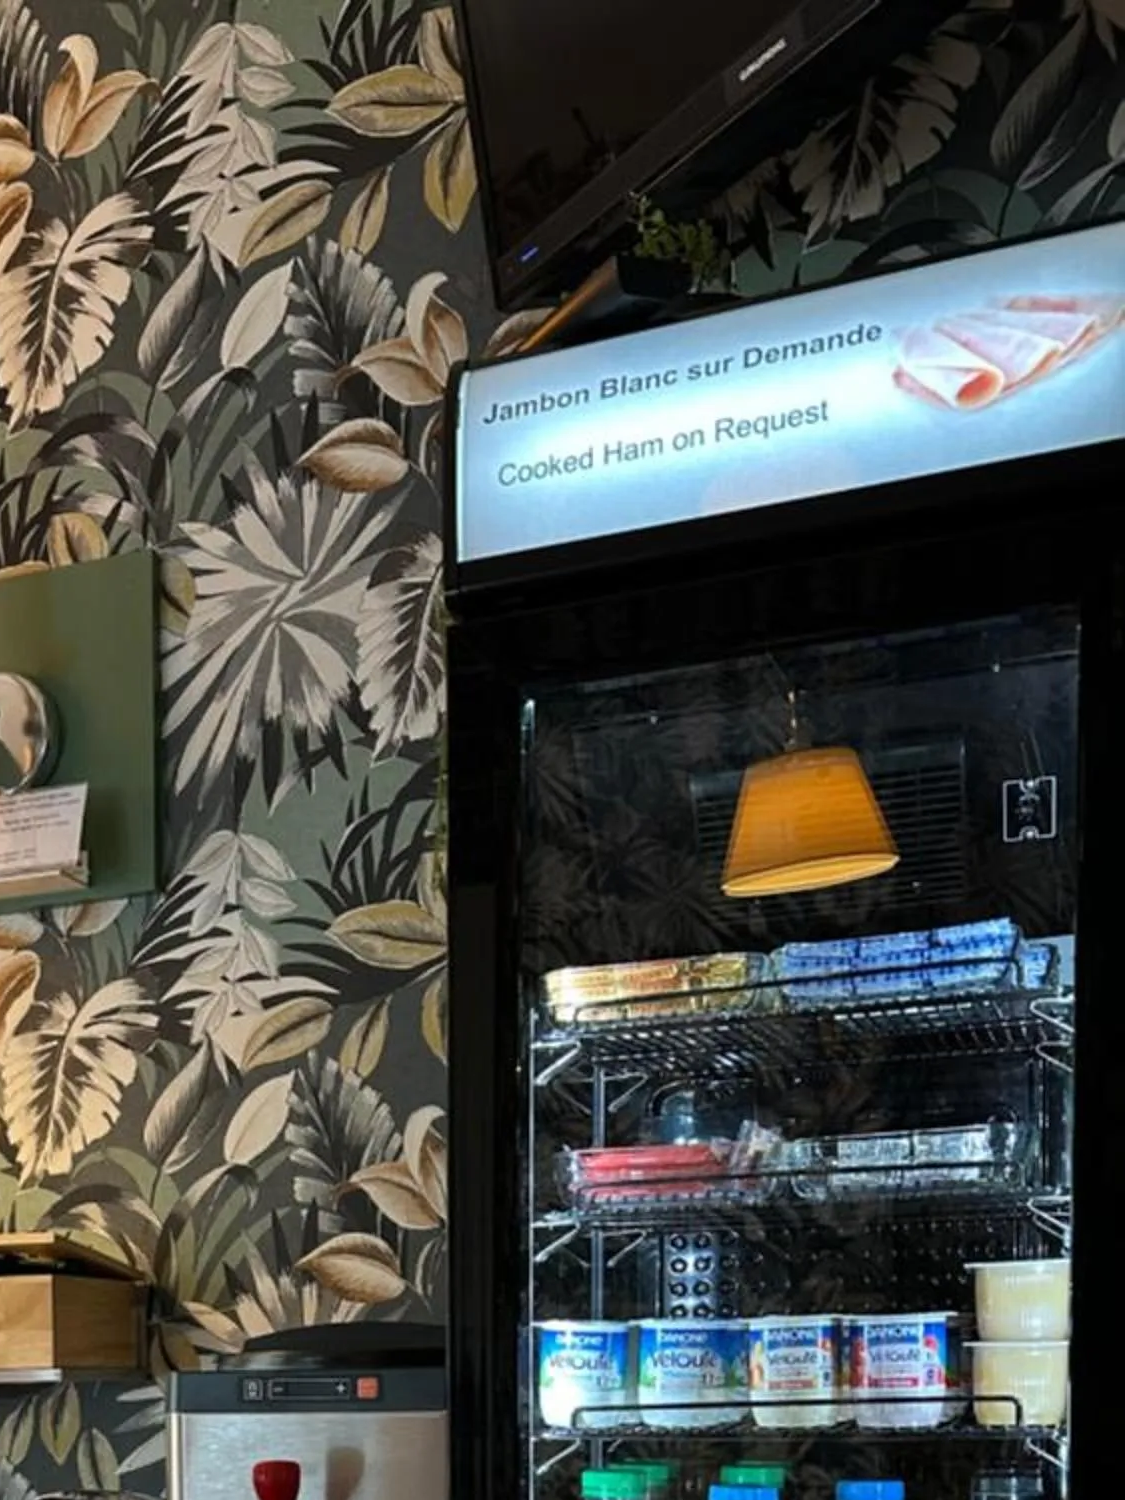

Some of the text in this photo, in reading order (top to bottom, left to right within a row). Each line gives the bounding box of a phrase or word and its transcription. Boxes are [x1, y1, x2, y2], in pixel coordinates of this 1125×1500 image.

[483, 323, 882, 425] Jambon Blanc sur Demande
[497, 400, 829, 487] Cooked Ham on Request
